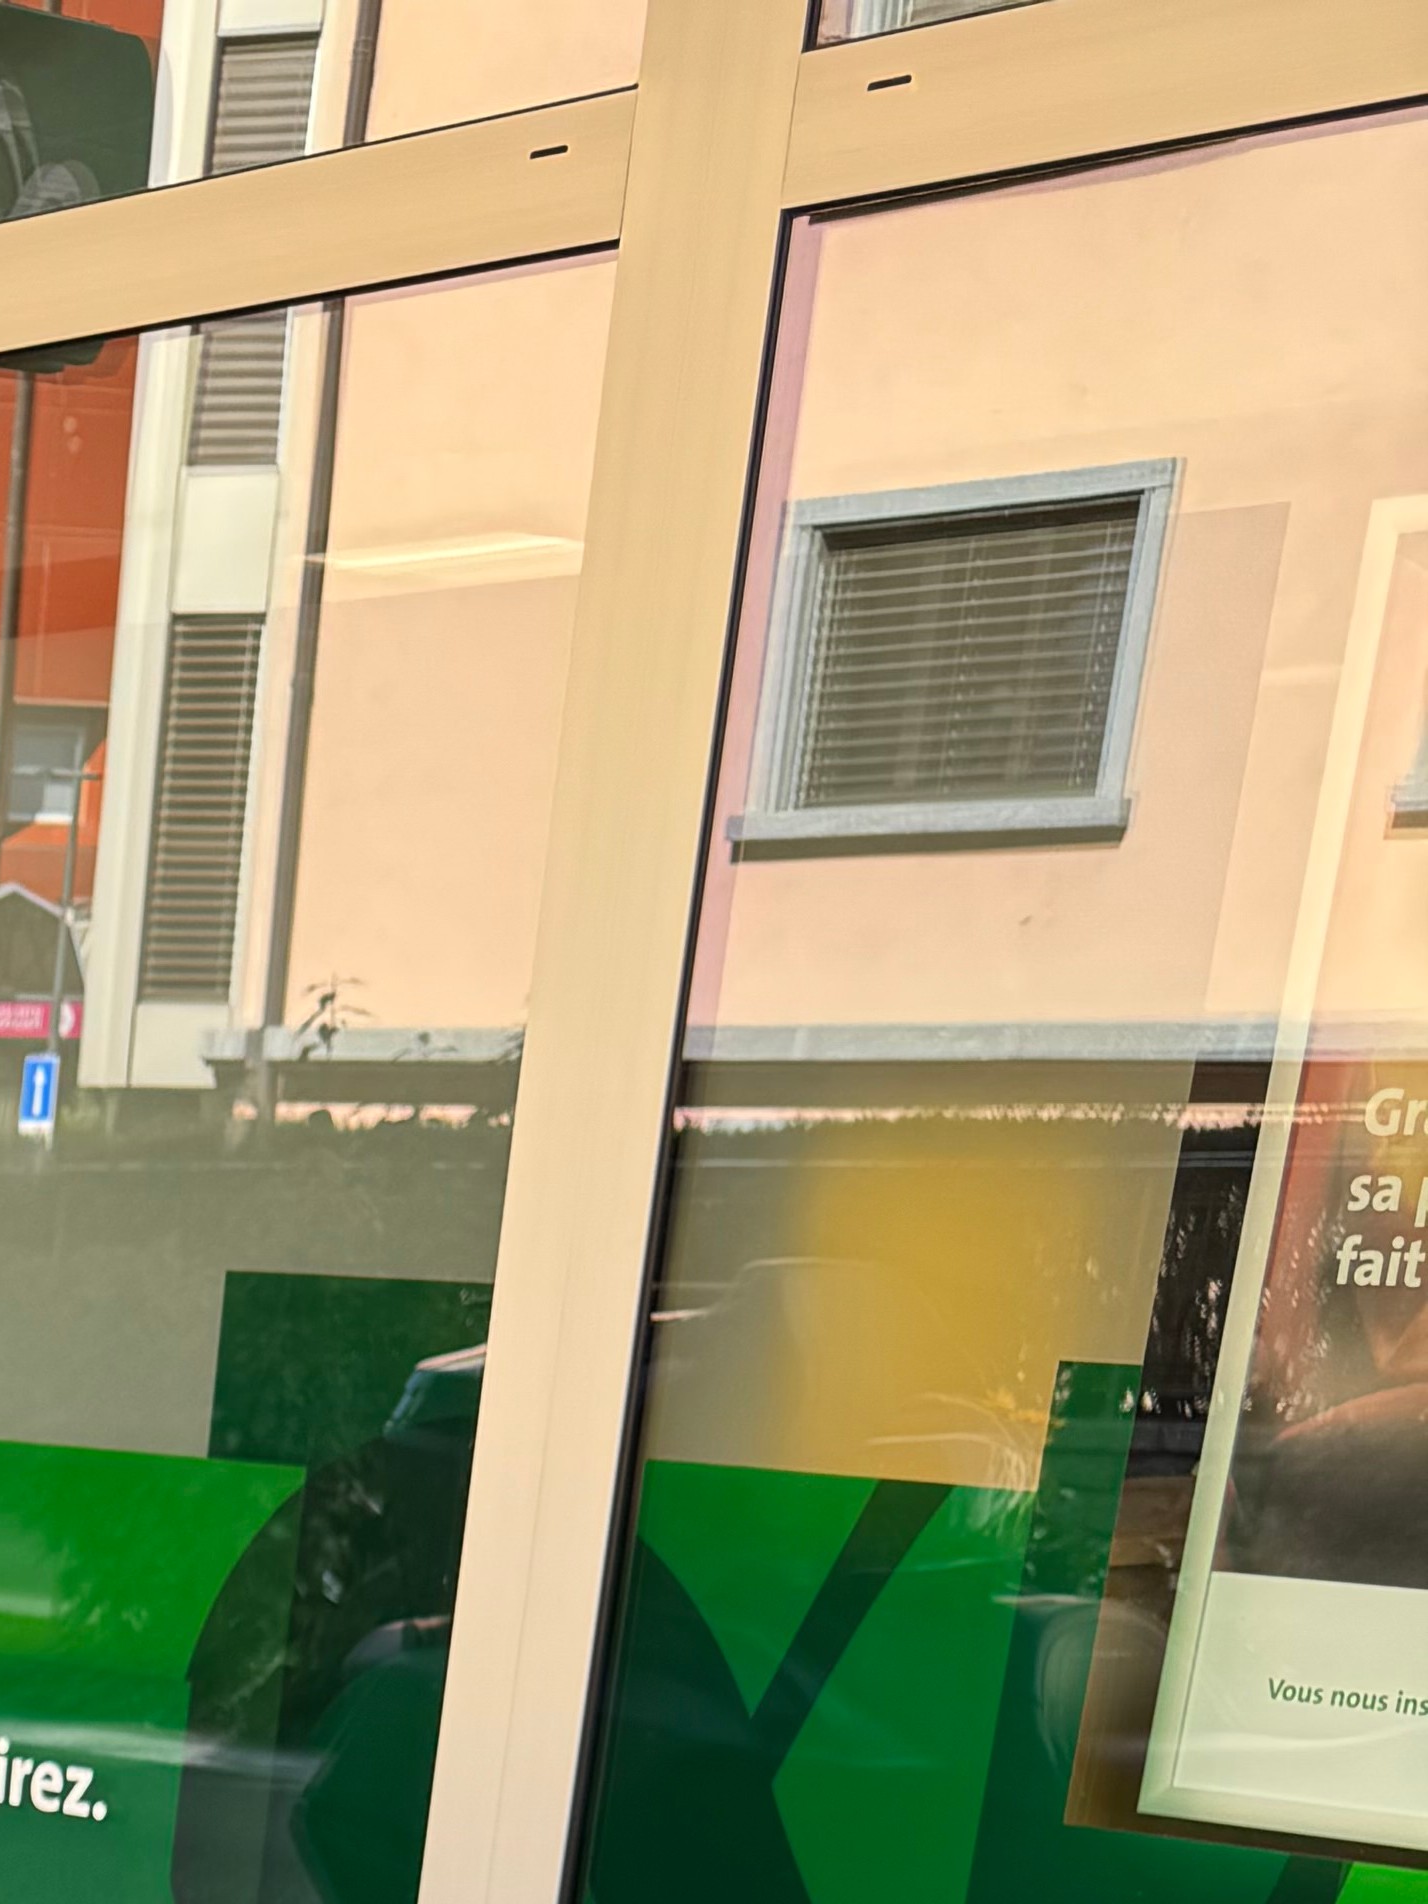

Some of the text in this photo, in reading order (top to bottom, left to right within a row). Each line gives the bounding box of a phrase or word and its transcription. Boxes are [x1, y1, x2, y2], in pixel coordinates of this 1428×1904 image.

[1365, 1088, 1428, 1136] Gr
[1347, 1175, 1402, 1211] sa
[1336, 1234, 1425, 1288] fait
[1269, 1678, 1324, 1705] Vous
[1330, 1690, 1389, 1712] nous
